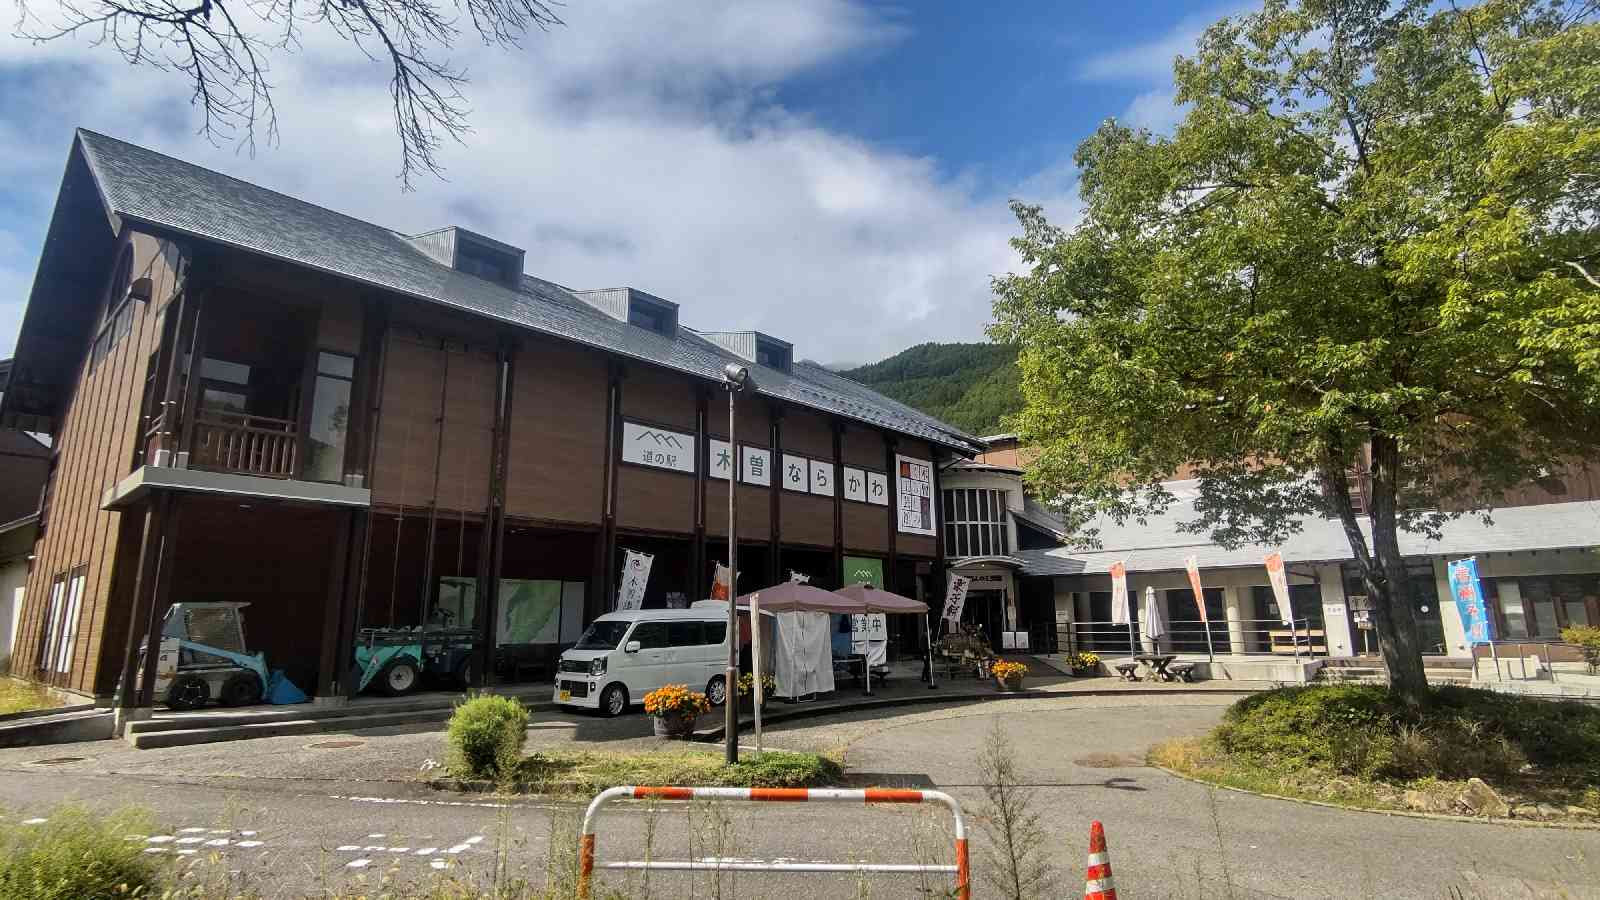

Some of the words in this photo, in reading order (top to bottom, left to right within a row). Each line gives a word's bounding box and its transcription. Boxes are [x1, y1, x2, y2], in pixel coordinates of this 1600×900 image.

[642, 449, 678, 467] 道の駅
[716, 449, 883, 497] 木曽ならかわ
